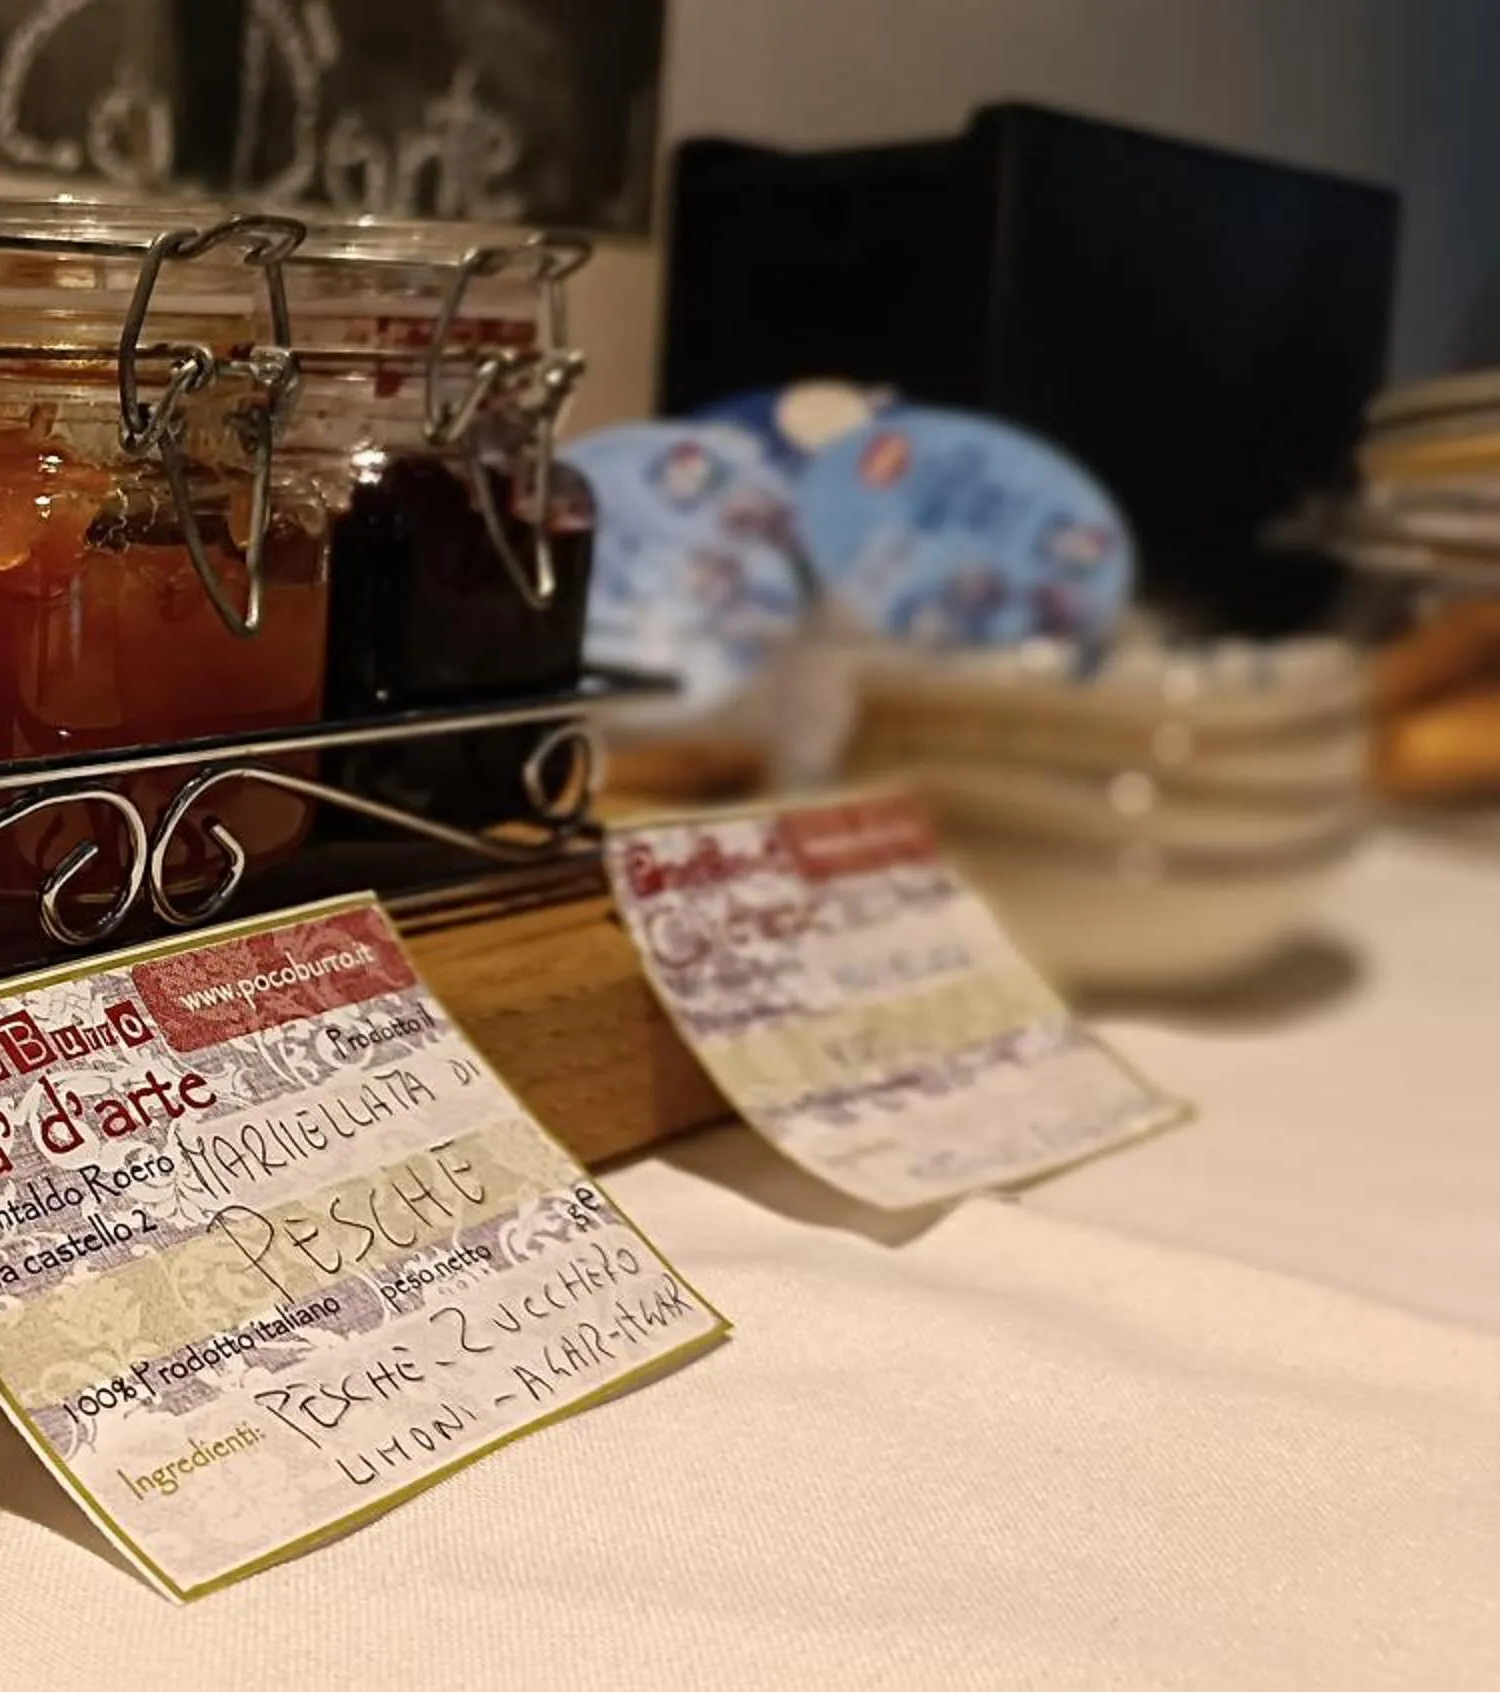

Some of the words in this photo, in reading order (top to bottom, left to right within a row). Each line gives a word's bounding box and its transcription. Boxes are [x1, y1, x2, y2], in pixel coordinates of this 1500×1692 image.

[180, 942, 375, 1012] www.pocoburro.it
[325, 1015, 421, 1060] Prodotto
[449, 1059, 482, 1086] DI
[40, 1071, 217, 1154] d'arte
[79, 1155, 175, 1203] Roero
[23, 1216, 132, 1276] castello
[131, 1208, 158, 1233] 2
[206, 1140, 486, 1305] PESCHE
[380, 1265, 434, 1315] peso
[434, 1243, 492, 1283] netto
[63, 1379, 137, 1425] 100%
[131, 1331, 256, 1398] Prodotto
[250, 1295, 341, 1340] italiano
[116, 1423, 267, 1501] Ingredienti:
